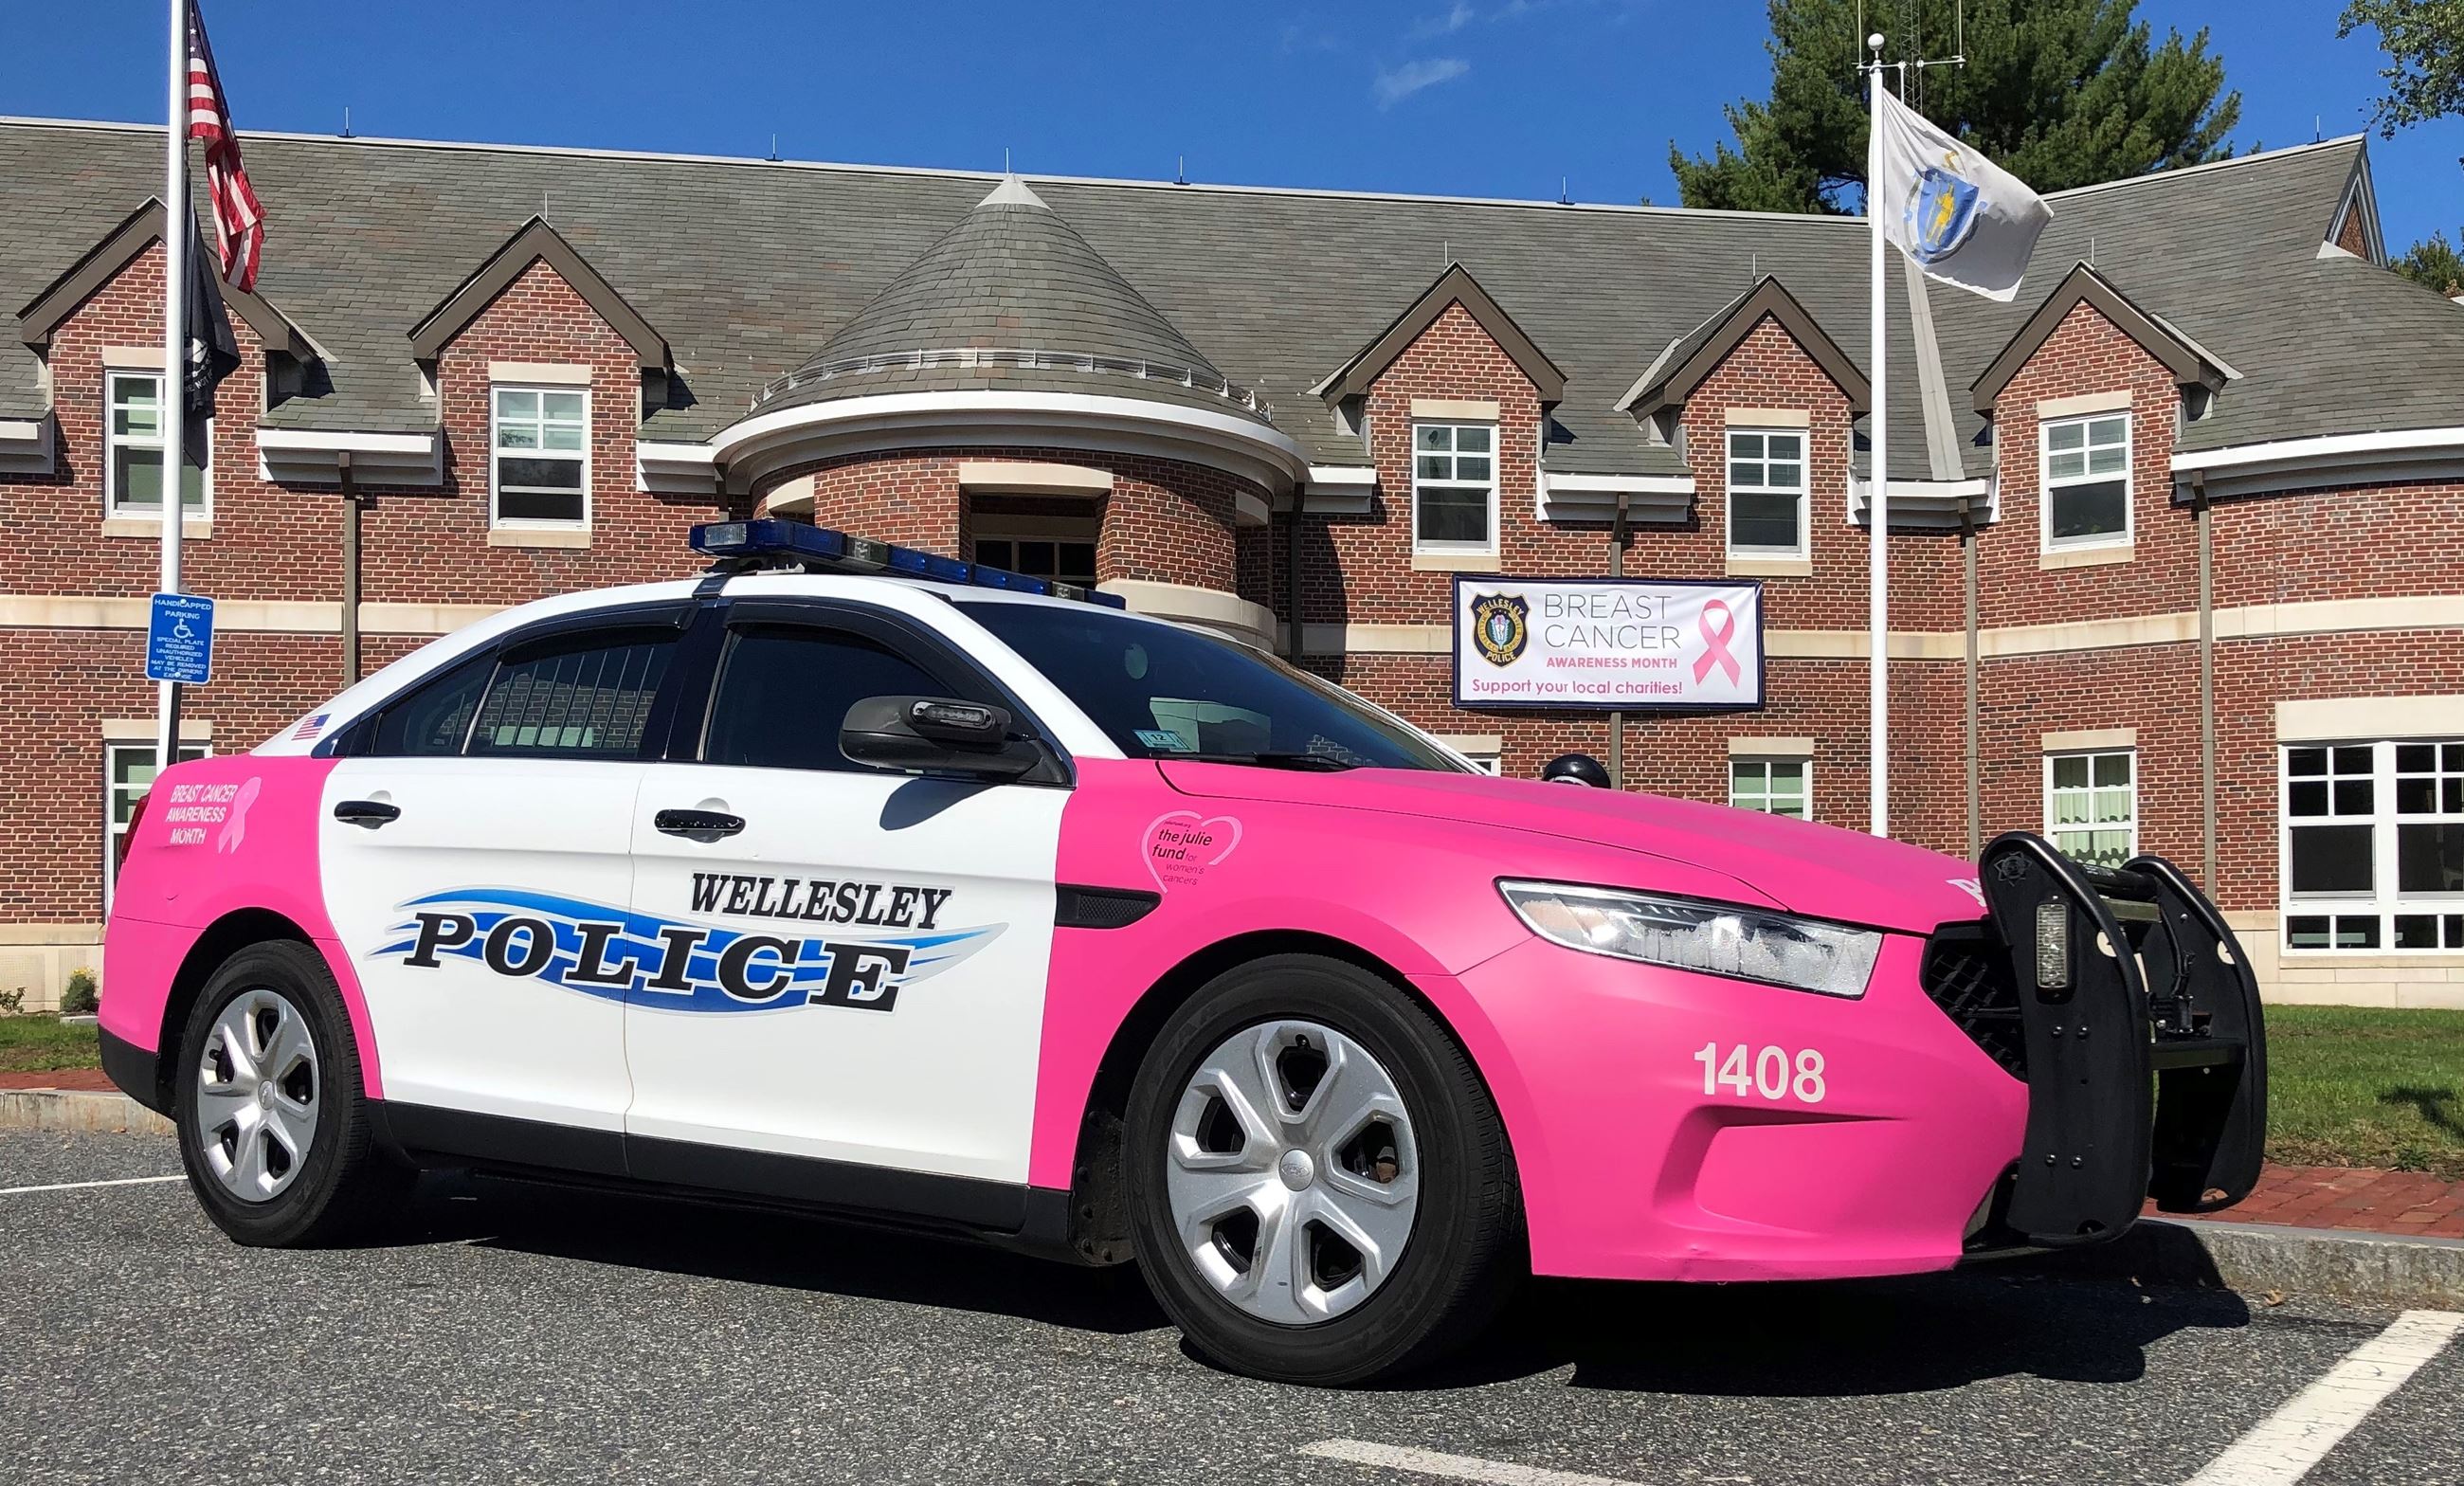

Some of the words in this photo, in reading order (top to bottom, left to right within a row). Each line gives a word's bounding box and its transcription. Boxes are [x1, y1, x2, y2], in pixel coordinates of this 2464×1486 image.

[165, 610, 200, 619] PARKING
[1476, 598, 1525, 615] WELLESLEY
[1545, 593, 1672, 621] BREAST
[1544, 624, 1682, 650] CANCER
[156, 648, 203, 657] UNAUTHORIZED
[1485, 652, 1516, 662] POLICE
[1546, 657, 1627, 669] AWARENESS
[1631, 657, 1678, 670] MONTH
[1472, 679, 1531, 695] Support
[1536, 681, 1568, 697] your
[1572, 680, 1611, 695] local
[1615, 680, 1683, 696] charities!
[170, 785, 203, 803] BREAST
[200, 784, 239, 803] CANCER
[165, 806, 227, 824] AWARENESS
[170, 827, 208, 844] MONTH
[1158, 828, 1180, 843] the
[1179, 829, 1213, 846] julie
[1152, 844, 1187, 861] fund
[1185, 852, 1197, 862] for
[1166, 863, 1205, 875] women's
[1162, 873, 1199, 886] cancers
[689, 871, 953, 931] WELLESLEY
[402, 911, 912, 1014] POLICE
[1694, 1042, 1826, 1104] 1408
